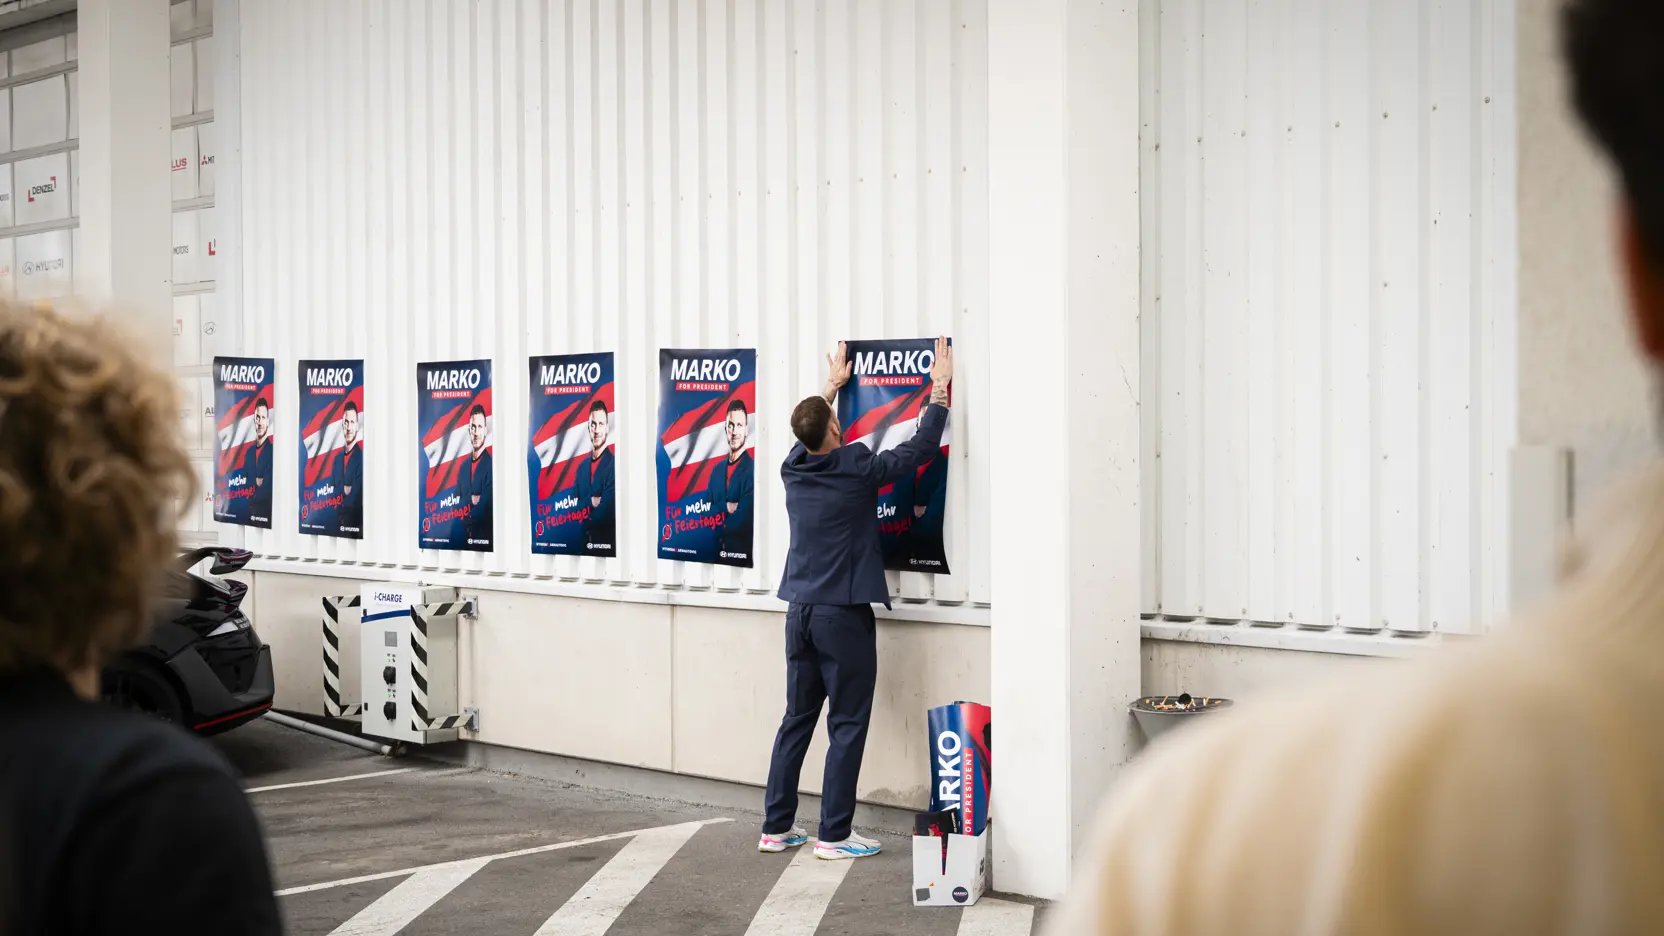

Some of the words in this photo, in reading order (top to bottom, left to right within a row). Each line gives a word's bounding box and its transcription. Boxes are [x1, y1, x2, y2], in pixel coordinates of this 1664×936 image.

[32, 184, 54, 195] DENZEL
[670, 359, 741, 381] MARKO
[853, 350, 935, 375] MARKO
[221, 364, 264, 383] MARKO
[306, 368, 353, 386] MARKO
[427, 369, 480, 389] MARKO
[540, 362, 601, 385] MARKO
[229, 474, 246, 487] mehr
[317, 483, 334, 497] mehr
[440, 493, 460, 508] mehr
[555, 495, 578, 511] mehr
[665, 505, 682, 519] Für
[685, 499, 711, 515] mehr
[877, 502, 896, 518] ehr
[432, 504, 472, 525] Feiertage!
[545, 505, 592, 530] Feiertage!
[675, 511, 726, 534] Feiertage!
[374, 592, 402, 603] i-CHARGE
